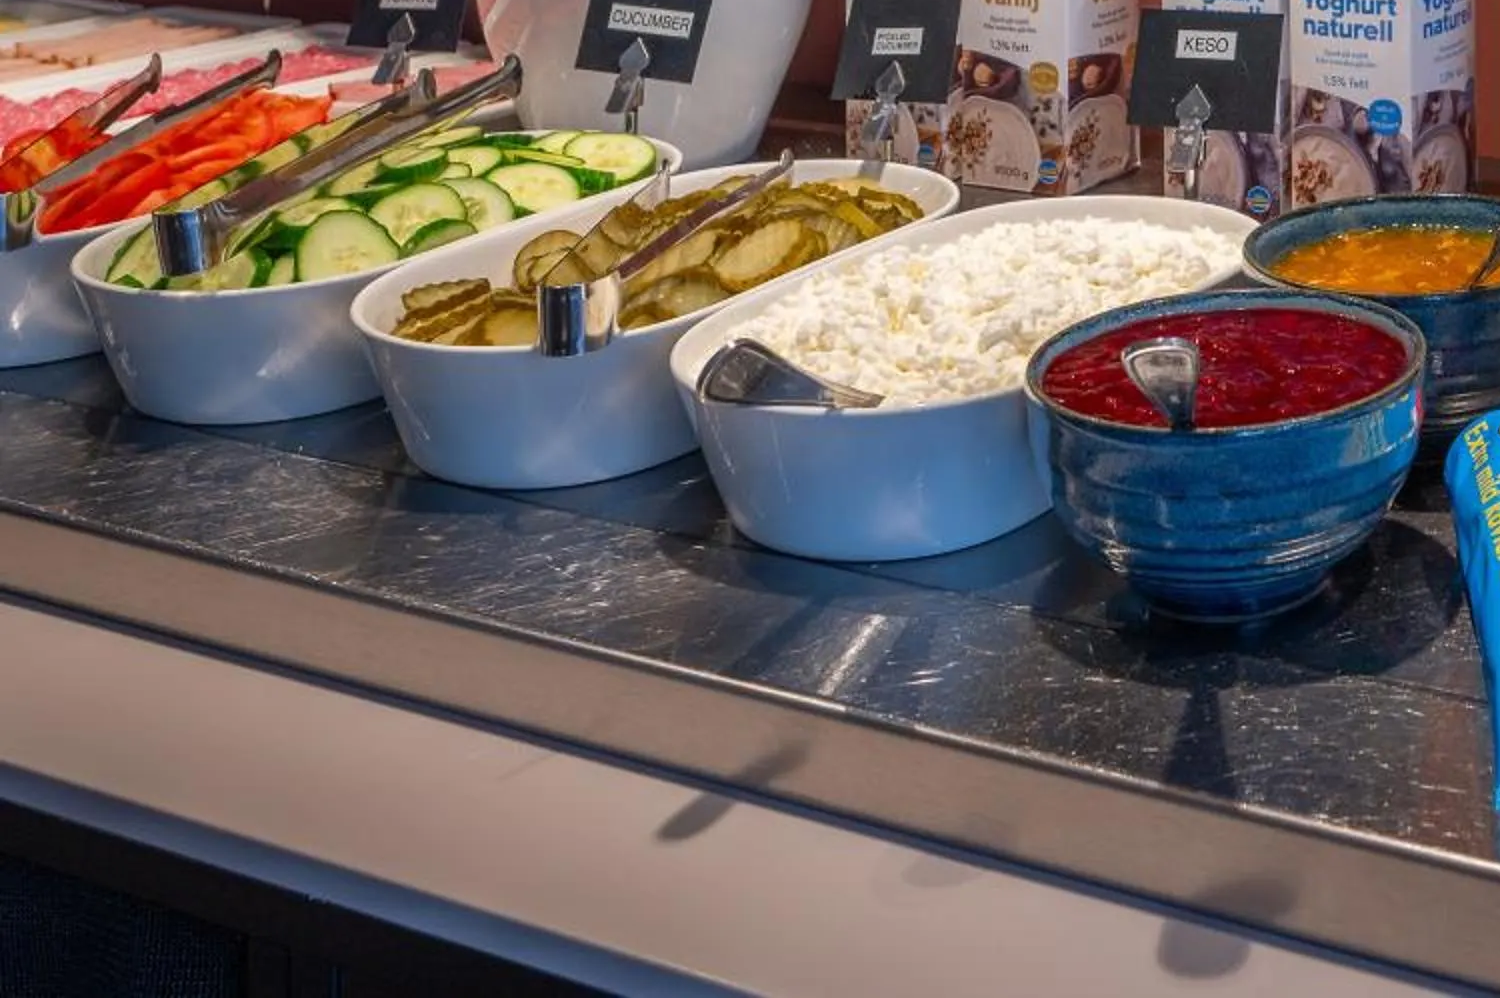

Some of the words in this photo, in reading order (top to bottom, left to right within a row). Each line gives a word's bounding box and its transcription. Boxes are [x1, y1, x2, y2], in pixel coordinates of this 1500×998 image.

[611, 8, 690, 31] CUCUMBER
[1303, 18, 1393, 42] naturell
[1183, 36, 1229, 53] KESO
